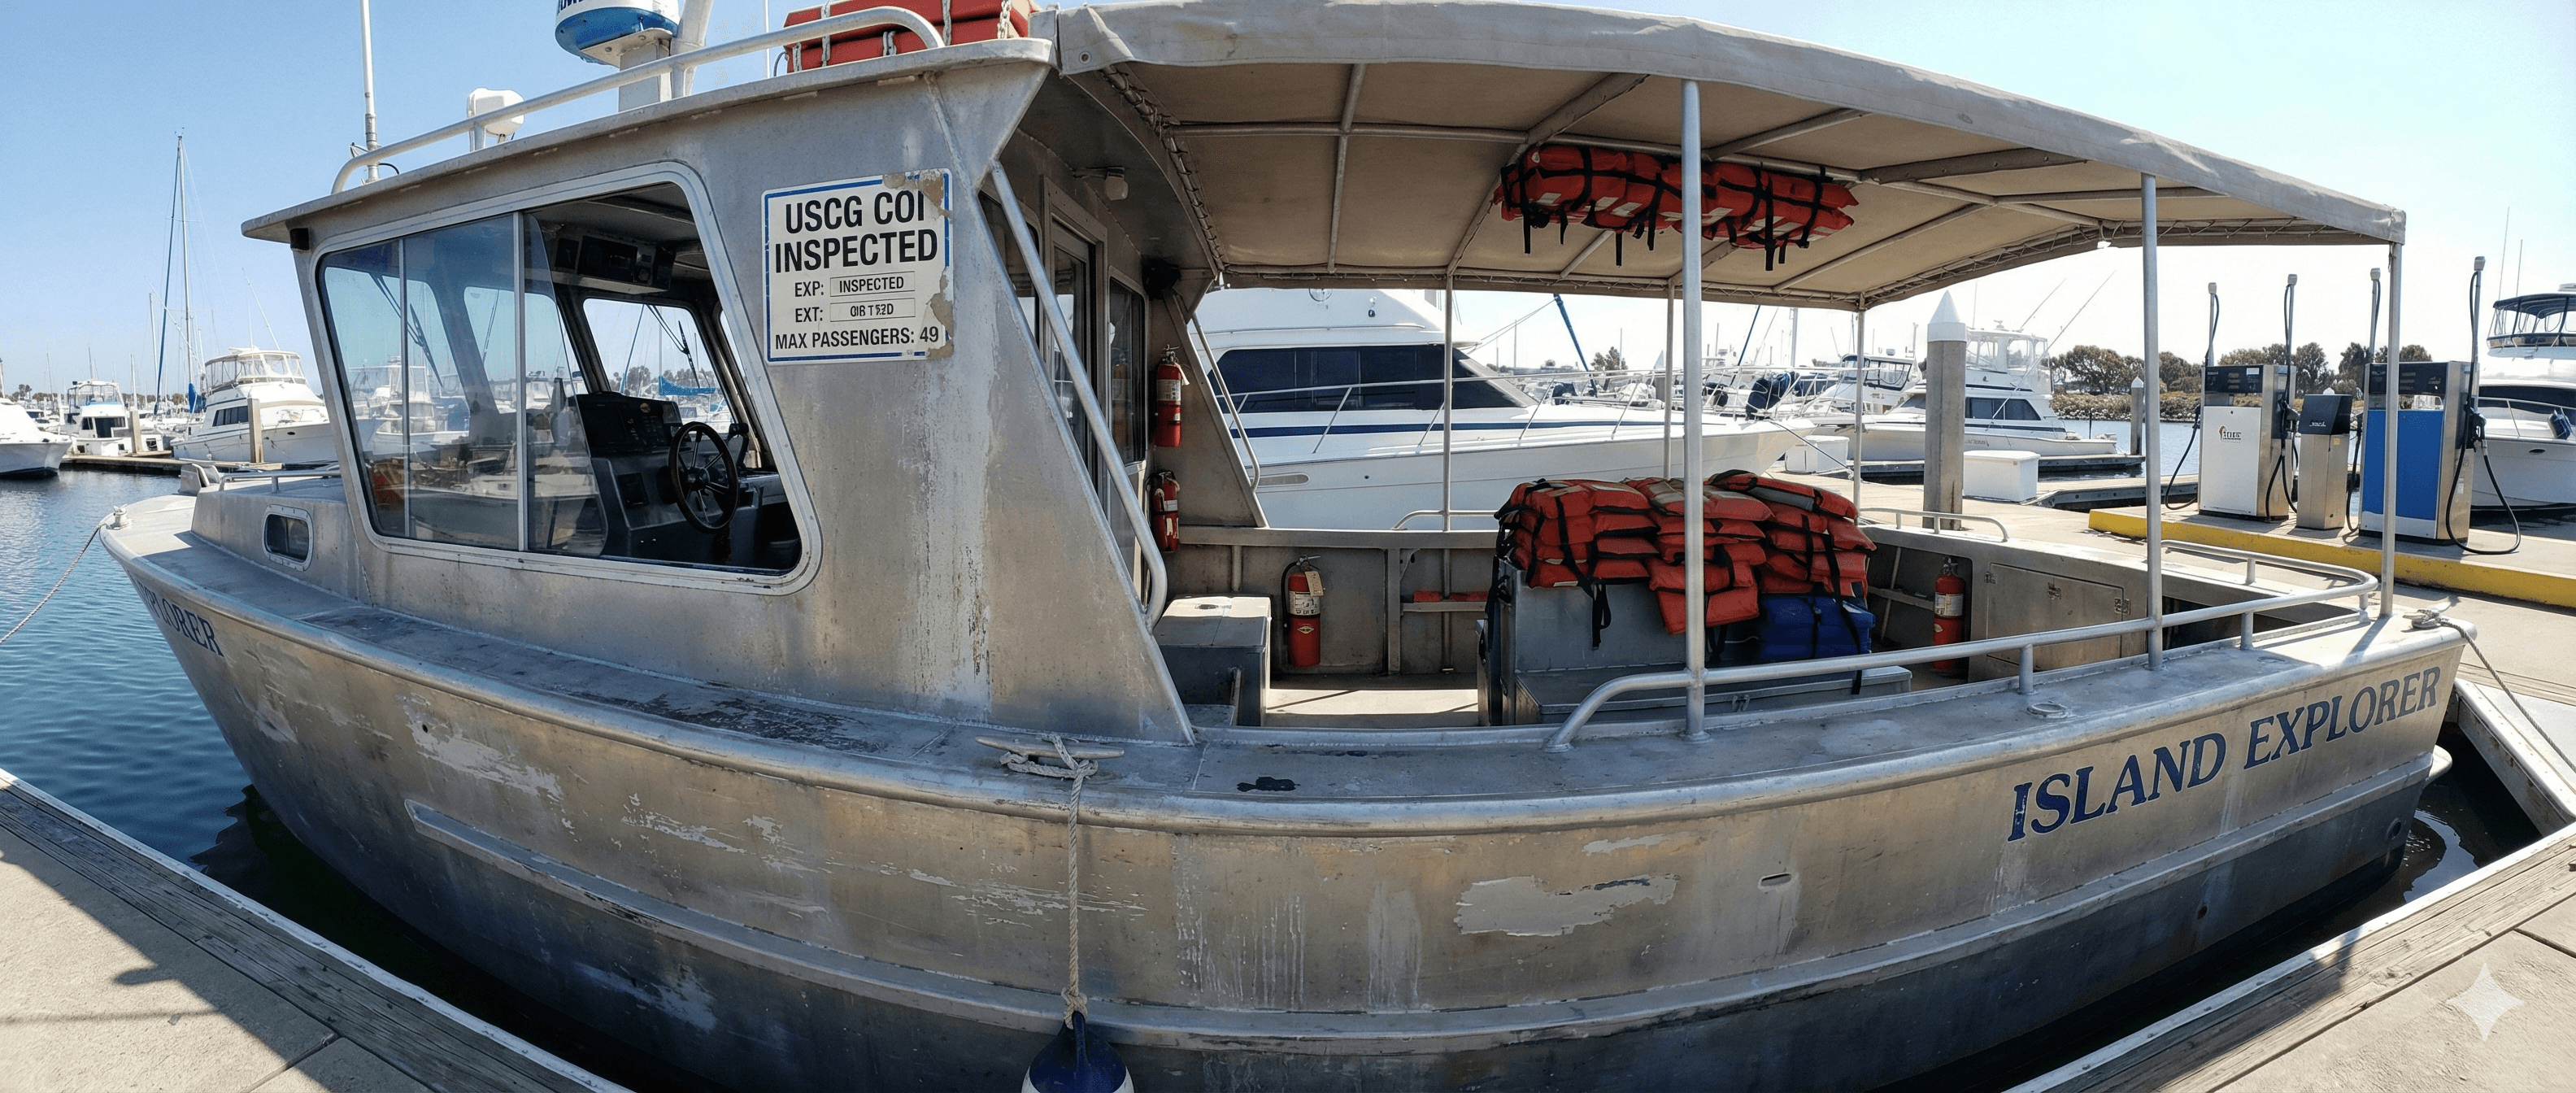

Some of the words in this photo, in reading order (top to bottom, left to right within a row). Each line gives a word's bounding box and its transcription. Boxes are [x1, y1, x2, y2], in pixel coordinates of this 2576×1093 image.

[785, 195, 862, 233] USCG
[873, 190, 925, 225] COI
[775, 229, 938, 274] INSPECTED
[794, 281, 825, 298] EXP:
[838, 276, 905, 294] INSPECTED
[794, 306, 824, 323] EXT:
[775, 333, 807, 350] MAX
[812, 327, 915, 348] PASSENGERS:
[919, 325, 939, 343] 49
[2007, 732, 2227, 843] ISLAND
[2243, 666, 2440, 770] EXPLORER
